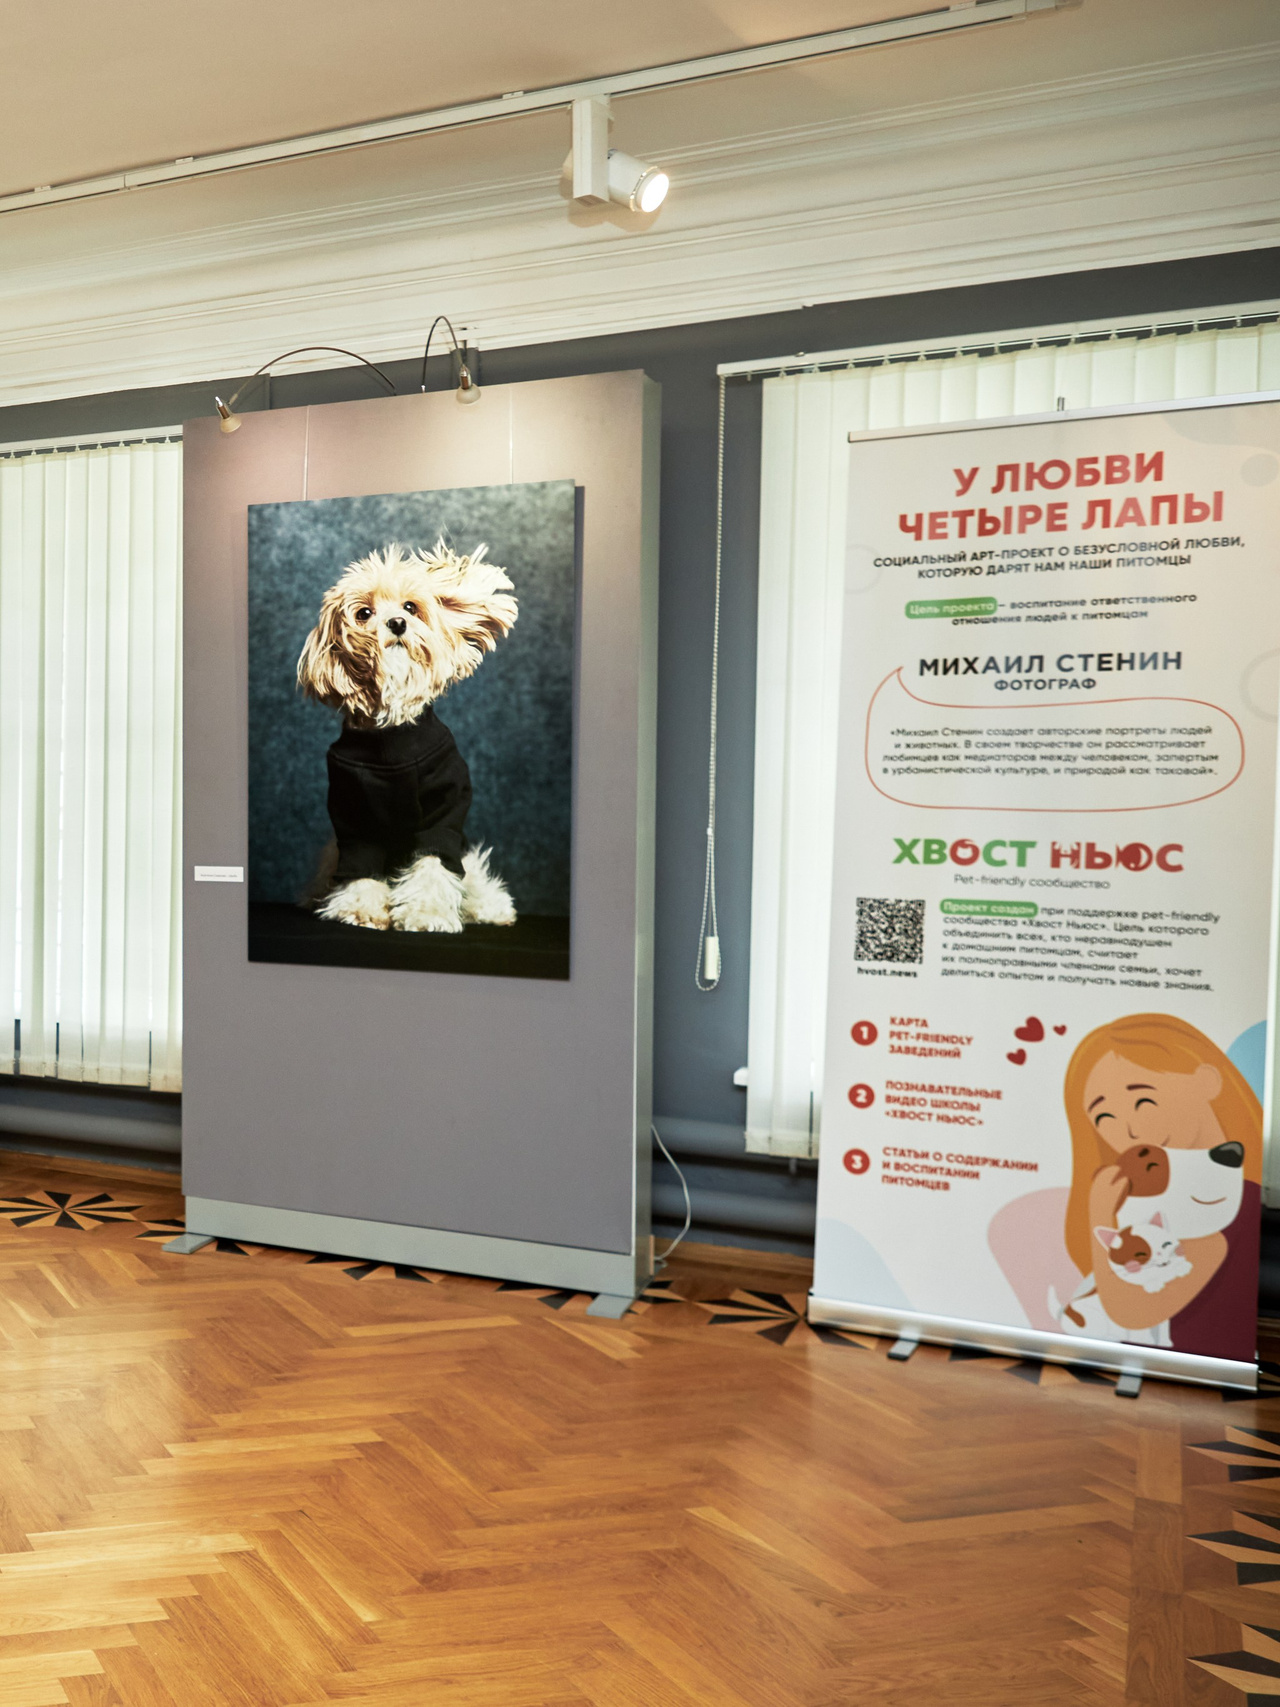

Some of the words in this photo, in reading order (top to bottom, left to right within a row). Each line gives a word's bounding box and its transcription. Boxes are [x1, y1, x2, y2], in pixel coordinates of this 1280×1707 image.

[953, 467, 980, 497] У
[991, 451, 1164, 494] ЛЮБВИ
[898, 502, 1068, 541] ЧЕТЫРЕ
[1081, 491, 1223, 530] ЛАПЫ
[873, 551, 967, 568] СОЦИАЛЬНЫЙ
[970, 547, 1054, 562] АРТ-ПРОЕКТ
[1058, 546, 1070, 556] О
[1073, 538, 1180, 556] БЕЗУСЛОВНОЙ
[1184, 536, 1245, 549] ЛЮБВИ,
[918, 565, 983, 579] КОТОРУЮ
[986, 563, 1030, 576] ДАРЯТ
[1034, 561, 1065, 572] НАМ
[1069, 559, 1112, 570] НАШИ
[1116, 555, 1191, 568] ПИТОМЦЫ
[910, 604, 940, 615] Цель
[942, 602, 995, 615] проекта
[1010, 599, 1087, 610] воспитание
[1090, 594, 1197, 606] ответственного
[952, 615, 1021, 626] отношения
[1025, 612, 1067, 623] людей
[1082, 611, 1148, 621] питомцам
[919, 655, 1044, 676] МИХАИЛ
[1056, 651, 1182, 673] СТЕНИН
[994, 678, 1096, 691] ФОТОГРАФ
[1037, 728, 1102, 738] авторские
[1105, 727, 1166, 737] портреты
[1170, 725, 1212, 736] людей
[964, 739, 972, 749] В
[1105, 741, 1206, 750] рассматривает
[892, 838, 1038, 868] ХВОСТ
[1050, 841, 1185, 873] НЬЮС
[954, 874, 1027, 888] Pet-friendly
[1029, 877, 1111, 890] сообщество
[943, 902, 988, 912] Проект
[990, 904, 1036, 915] создан
[1040, 907, 1065, 917] при
[1067, 908, 1138, 920] поддержке
[1142, 911, 1220, 924] pet-friendly
[1113, 922, 1145, 933] Цель
[1148, 926, 1209, 937] которого
[857, 966, 918, 978] hvost.news
[890, 1016, 929, 1028] КАРТА
[859, 1026, 869, 1040] 1
[889, 1031, 973, 1046] PET-FRIENDLY
[889, 1044, 961, 1058] ЗАВЕДЕНИЙ
[855, 1089, 868, 1103] 2
[885, 1080, 1003, 1100] ПОЗНАВАТЕЛЬНЫЕ
[885, 1095, 927, 1107] ВИДЕО
[930, 1100, 981, 1112] ШКОЛЫ
[885, 1109, 934, 1121] «ХВОСТ
[936, 1114, 984, 1126] НЬЮС»
[851, 1155, 863, 1169] 3
[882, 1147, 930, 1160] СТАТЬИ
[932, 1151, 943, 1161] О
[945, 1154, 1039, 1172] СОДЕРЖАНИИ
[882, 1161, 890, 1170] И
[894, 1162, 980, 1180] ВОСПИТАНИИ
[882, 1174, 950, 1191] ПИТОМЦЕВ
